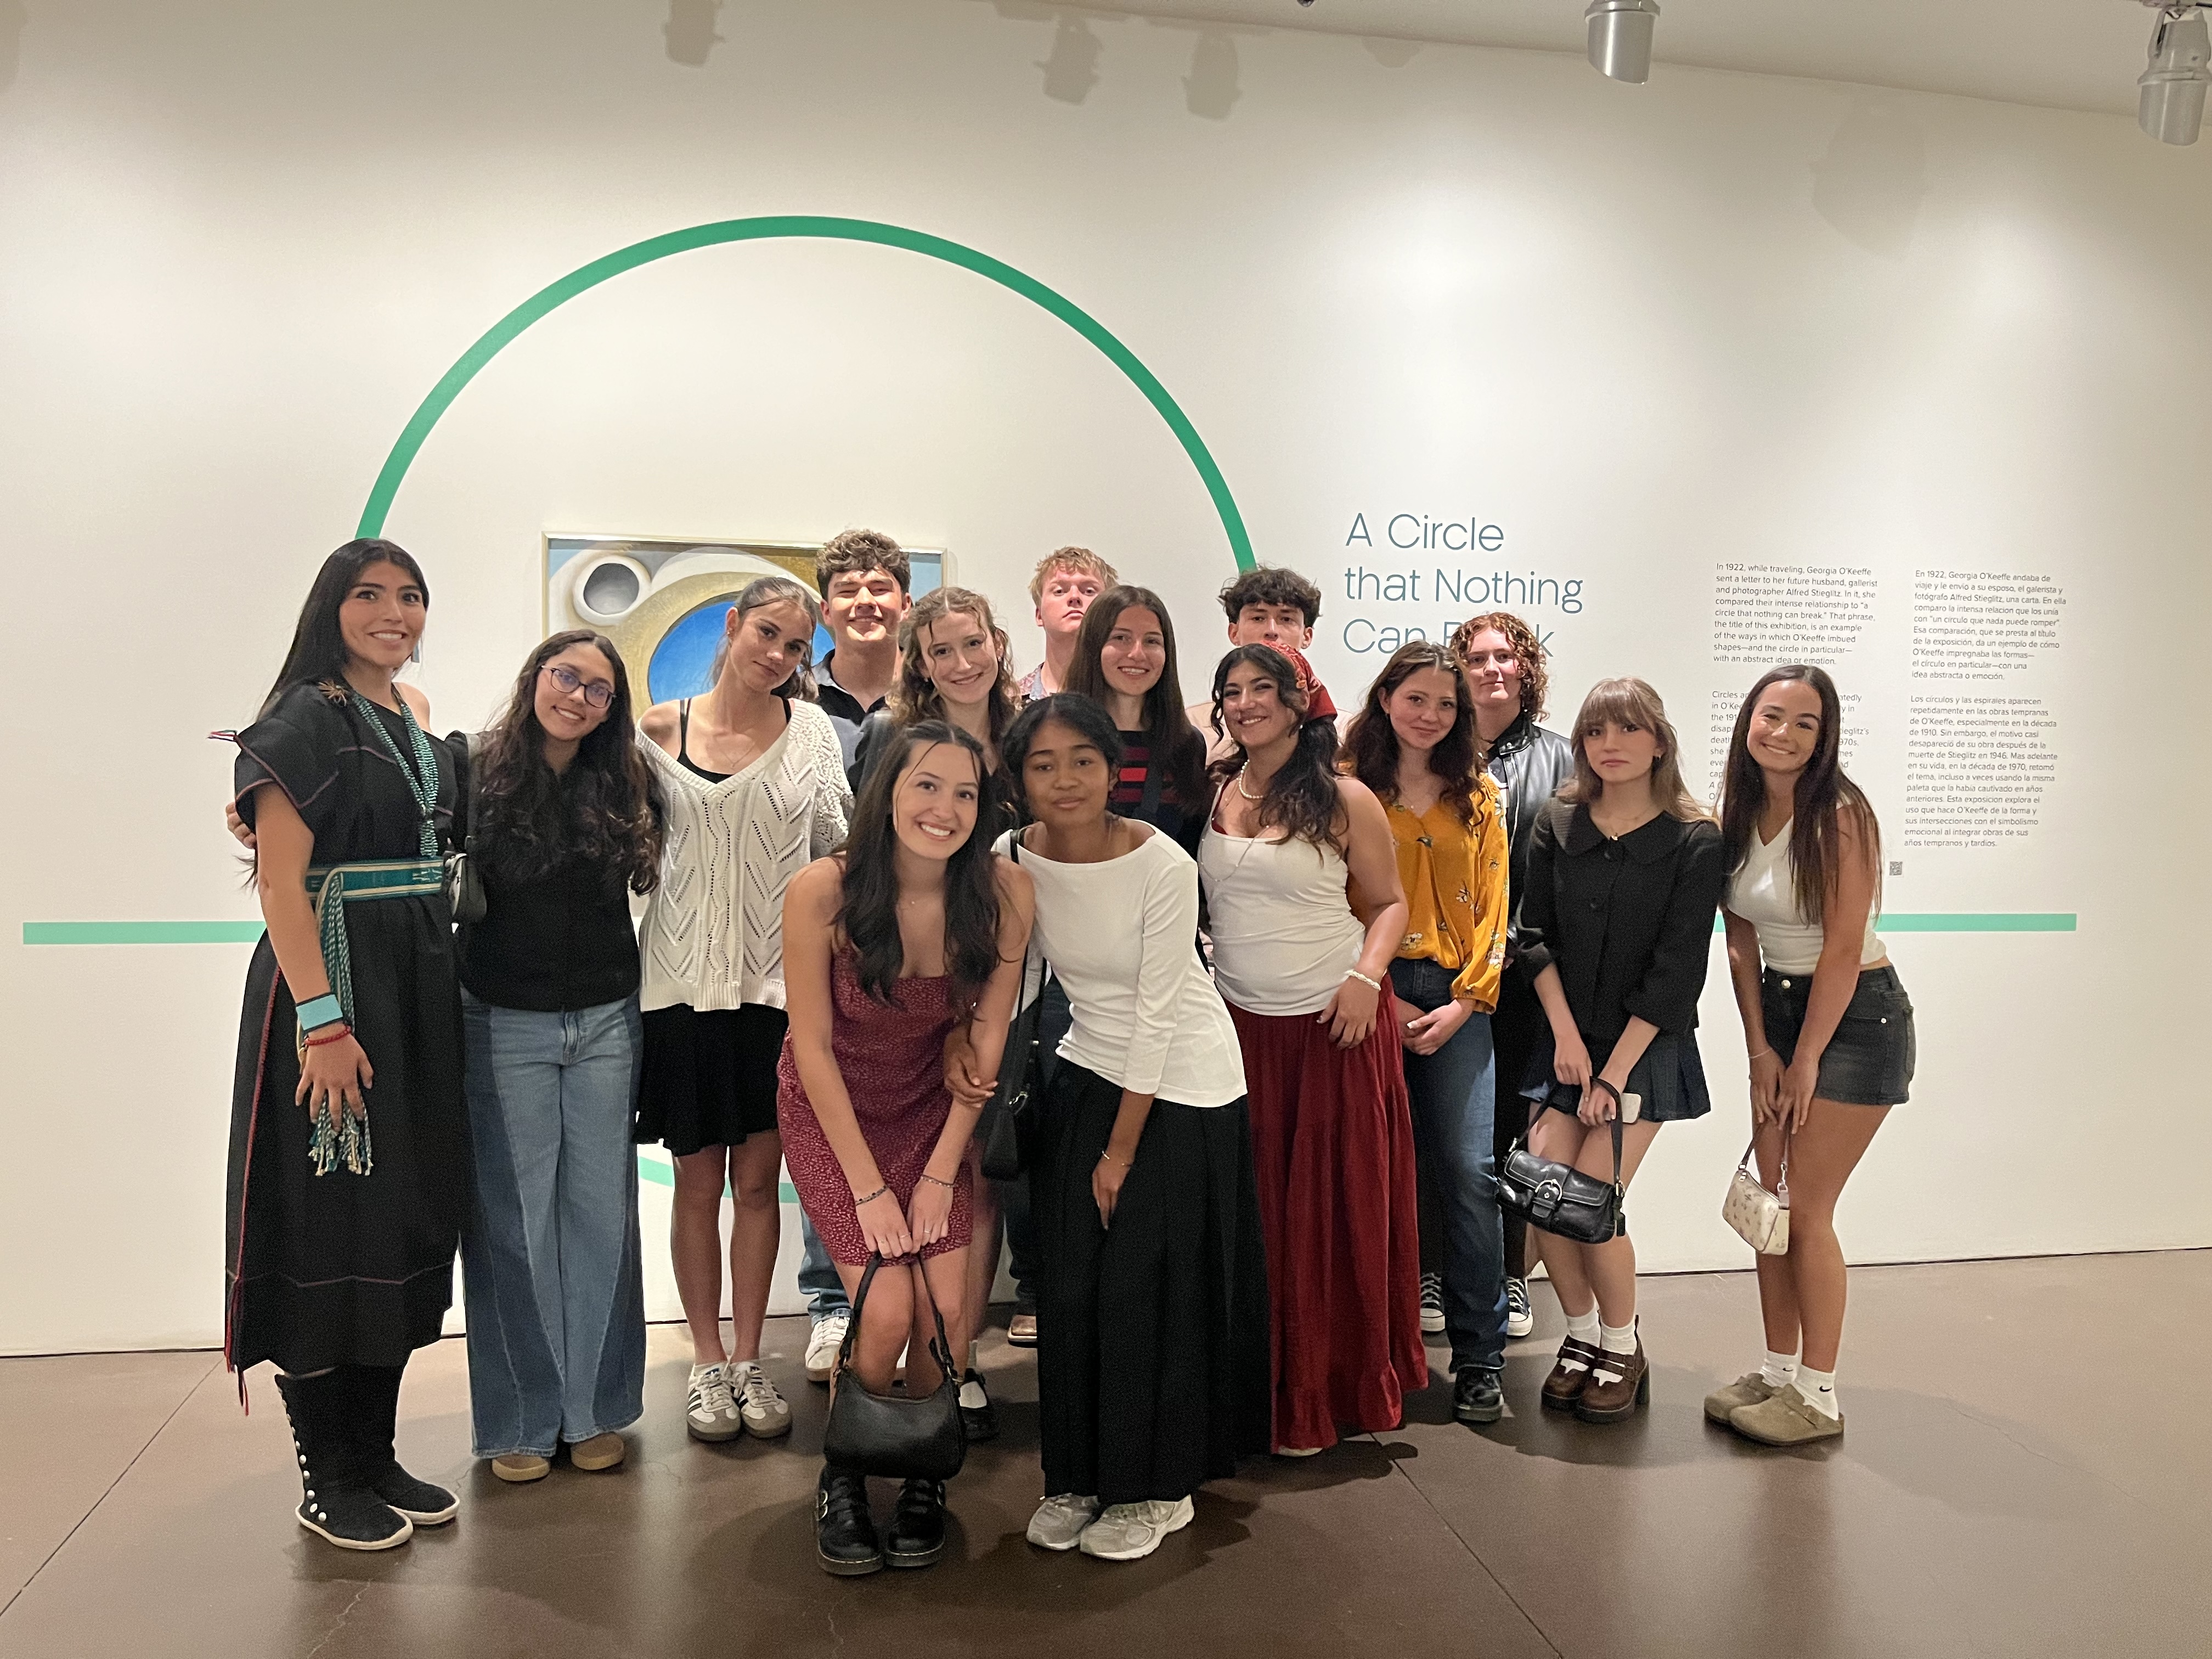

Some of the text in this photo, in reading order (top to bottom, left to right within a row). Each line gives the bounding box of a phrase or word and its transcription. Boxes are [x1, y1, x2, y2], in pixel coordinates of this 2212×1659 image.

[1346, 513, 1504, 552] A Circle
[1807, 566, 1836, 576] Georgia
[1848, 579, 1877, 588] gallerist
[1345, 566, 1583, 614] that Nothing
[1732, 586, 1784, 596] photographer
[1715, 598, 1753, 606] compared
[1805, 601, 1849, 610] relationship
[1754, 611, 1782, 619] nothing
[1830, 624, 1861, 633] example
[1343, 618, 1426, 654] Can
